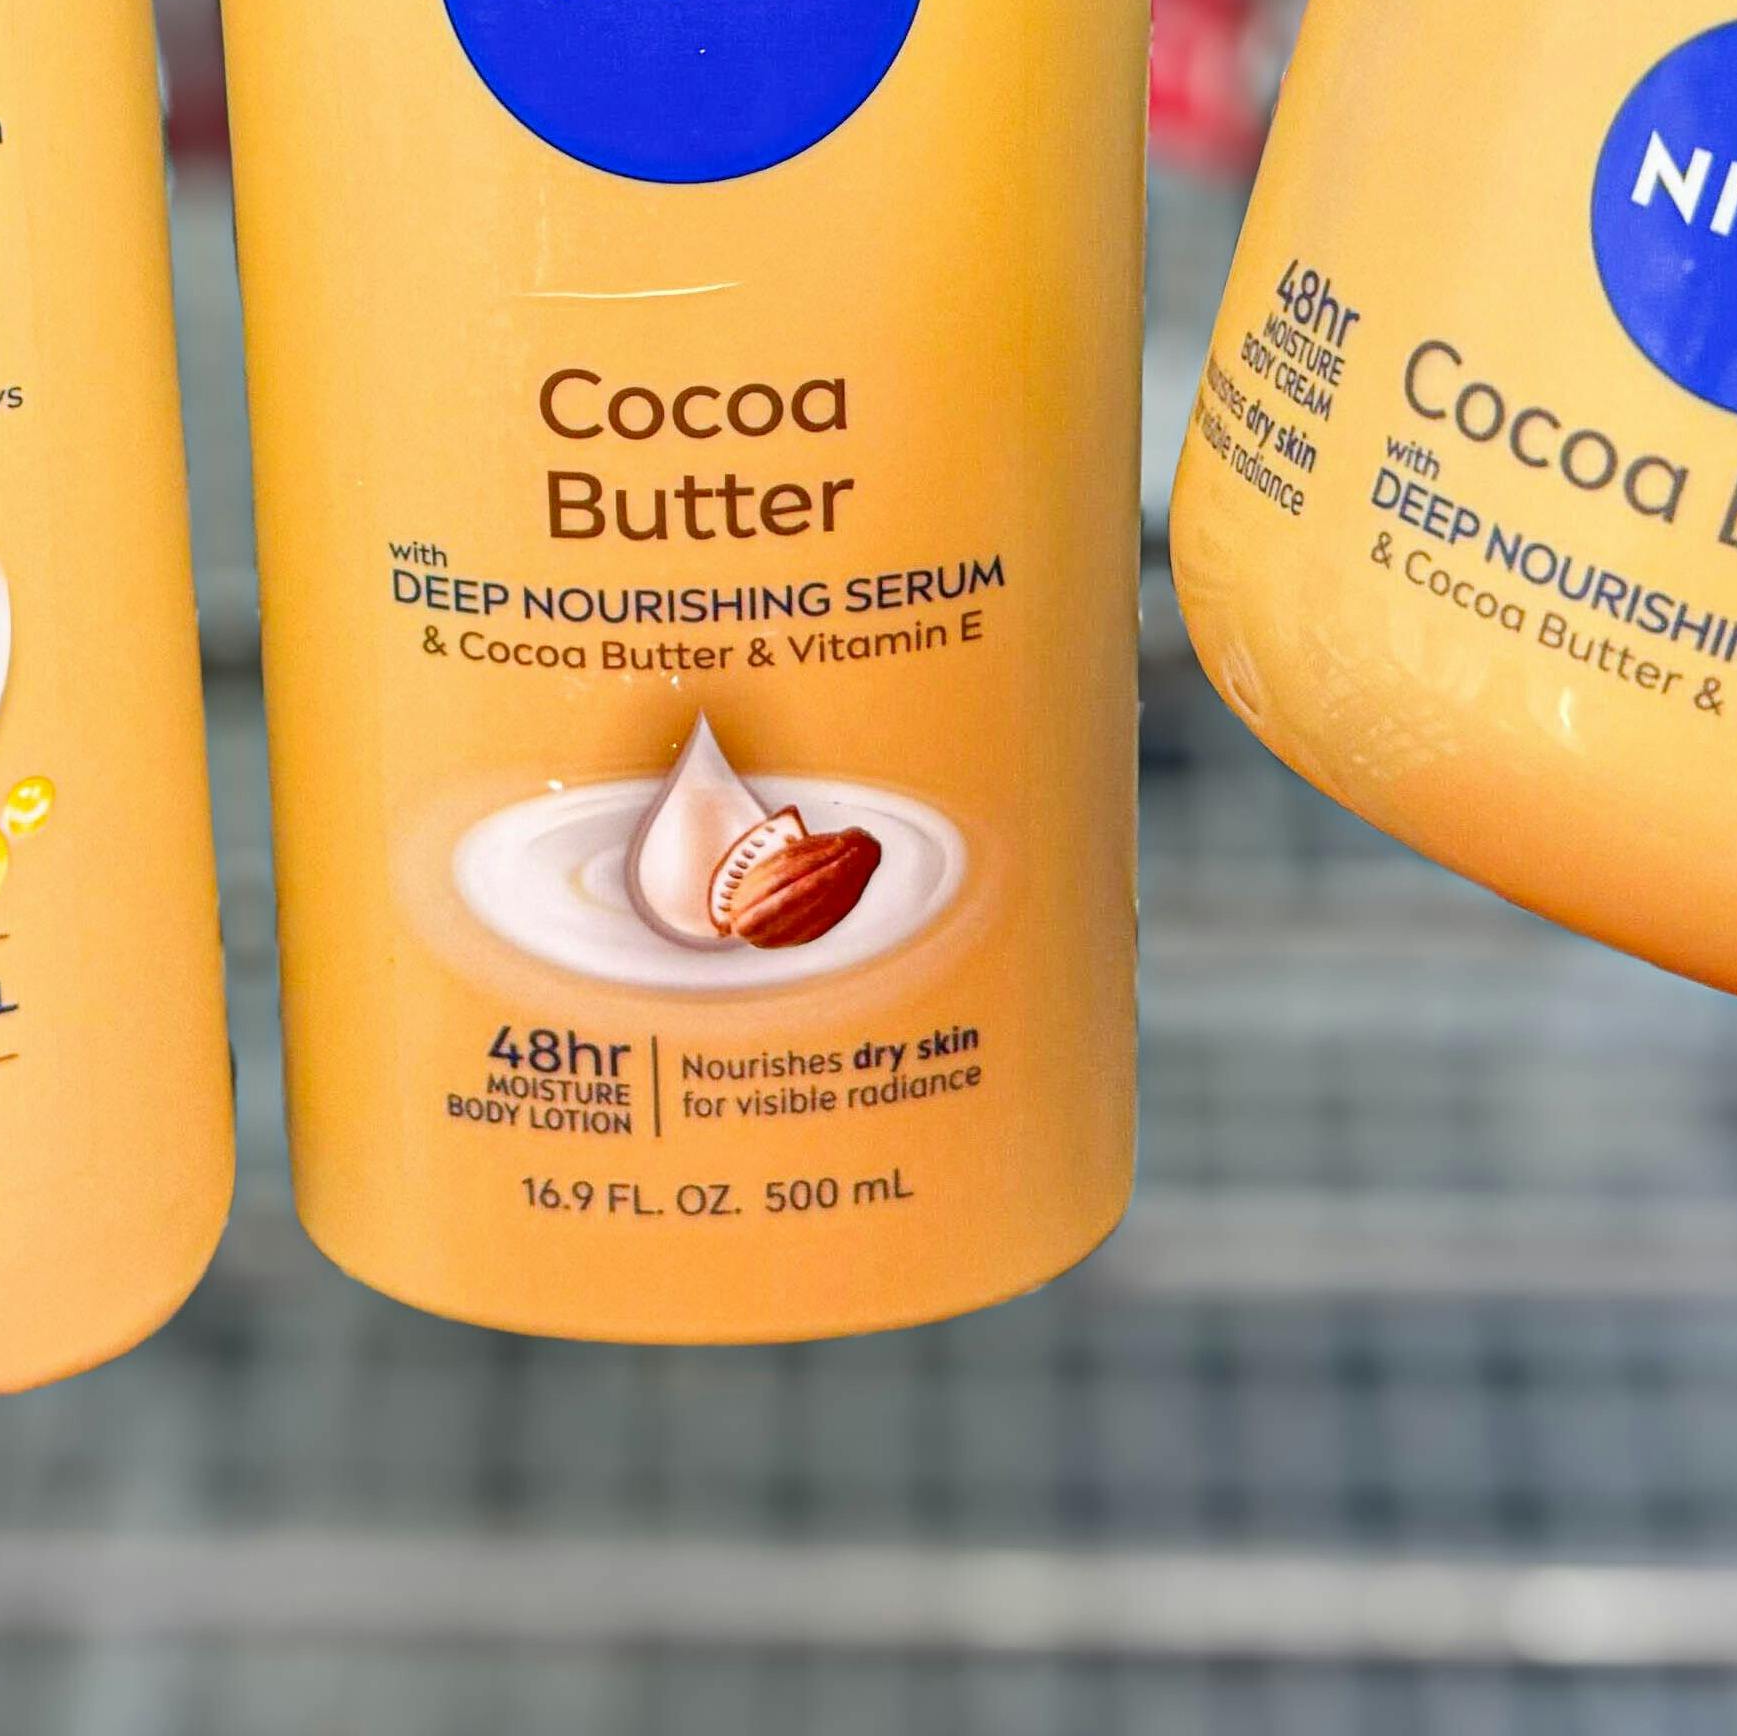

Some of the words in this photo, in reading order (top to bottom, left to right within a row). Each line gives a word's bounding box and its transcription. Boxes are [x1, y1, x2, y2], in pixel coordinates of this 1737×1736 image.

[1276, 259, 1361, 348] 48hr
[1240, 331, 1277, 381] BODY
[1275, 361, 1333, 423] CREAM
[1264, 312, 1346, 388] MOISTURE
[538, 368, 849, 441] Cocoa
[1246, 398, 1275, 450] dry
[1274, 424, 1317, 474] skin
[1404, 338, 1690, 525] Cocoa
[1230, 442, 1305, 516] radiance
[1385, 434, 1442, 482] with
[547, 469, 856, 541] Butter
[1370, 466, 1482, 547] DEEP
[388, 539, 449, 569] with
[391, 566, 510, 617] DEEP
[523, 581, 831, 625] NOURISHING
[844, 554, 1006, 613] SERUM
[421, 625, 449, 658] &
[458, 631, 588, 670] Cocoa
[601, 640, 735, 672] Butter
[746, 637, 777, 667] &
[786, 620, 948, 665] Vitamin
[960, 609, 984, 644] E
[1370, 530, 1394, 570] &
[1404, 548, 1528, 636] Cocoa
[1536, 611, 1684, 701] Butter
[1693, 675, 1725, 716] &
[487, 1025, 633, 1079] 48hr
[681, 1050, 843, 1082] Nourishes
[853, 1039, 905, 1073] dry
[917, 1023, 981, 1060] skin
[447, 1093, 520, 1127] BODY
[530, 1106, 633, 1136] LOTION
[486, 1072, 632, 1106] MOISTURE
[681, 1089, 727, 1120] for
[736, 1083, 837, 1118] visible
[847, 1063, 984, 1110] radiance
[521, 1175, 595, 1212] 16.9
[608, 1182, 665, 1218] FL.
[675, 1182, 743, 1217] OZ.
[763, 1177, 839, 1213] 500
[851, 1166, 915, 1206] mL
